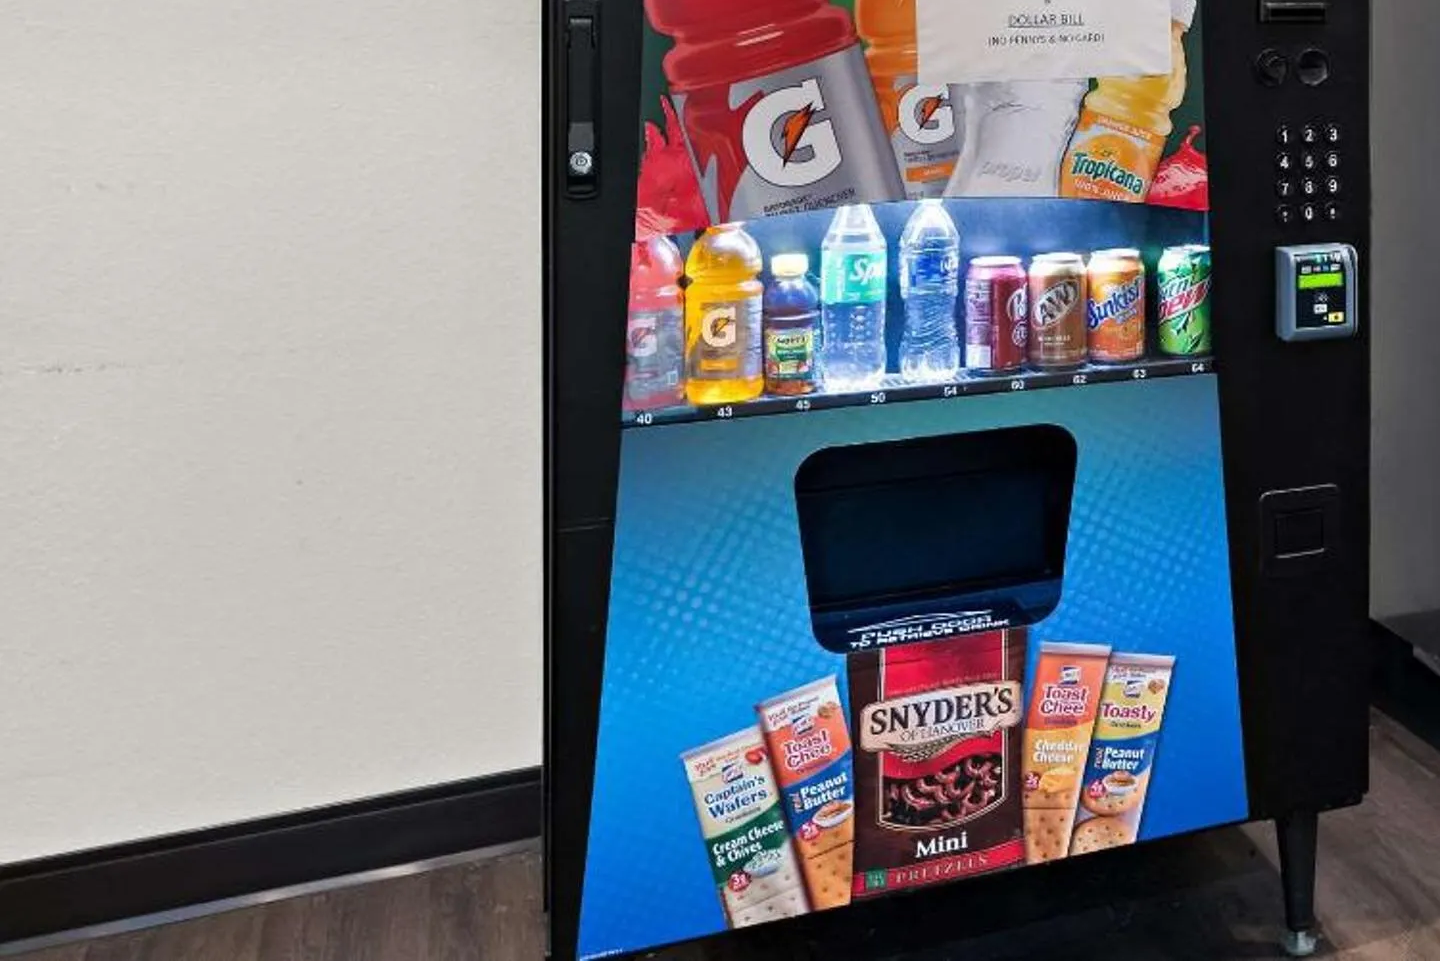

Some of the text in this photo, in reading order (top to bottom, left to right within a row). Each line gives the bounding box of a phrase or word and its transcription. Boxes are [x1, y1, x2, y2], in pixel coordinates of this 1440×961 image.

[1008, 12, 1084, 28] DOLLAR BILL
[898, 83, 956, 146] G
[742, 77, 842, 188] G
[1305, 129, 1314, 143] 2
[1329, 128, 1338, 142] 3
[1071, 152, 1144, 195] Tropicana
[1280, 154, 1289, 170] 4
[1304, 206, 1313, 221] 0
[702, 306, 737, 348] G
[870, 392, 886, 403] 50
[636, 412, 653, 425] 40
[1040, 699, 1085, 714] Chee
[1041, 684, 1089, 703] Toast
[869, 687, 1014, 736] SNYDER'S
[1102, 703, 1156, 723] Toasty
[785, 729, 828, 756] Toast
[1105, 746, 1145, 760] Peanut
[704, 774, 765, 806] Captain's
[800, 771, 849, 799] Peanut
[803, 785, 846, 811] Butter
[707, 788, 769, 819] Wafers
[712, 819, 785, 857] Cream Cheese
[915, 831, 969, 858] Mini
[727, 842, 763, 863] Chives
